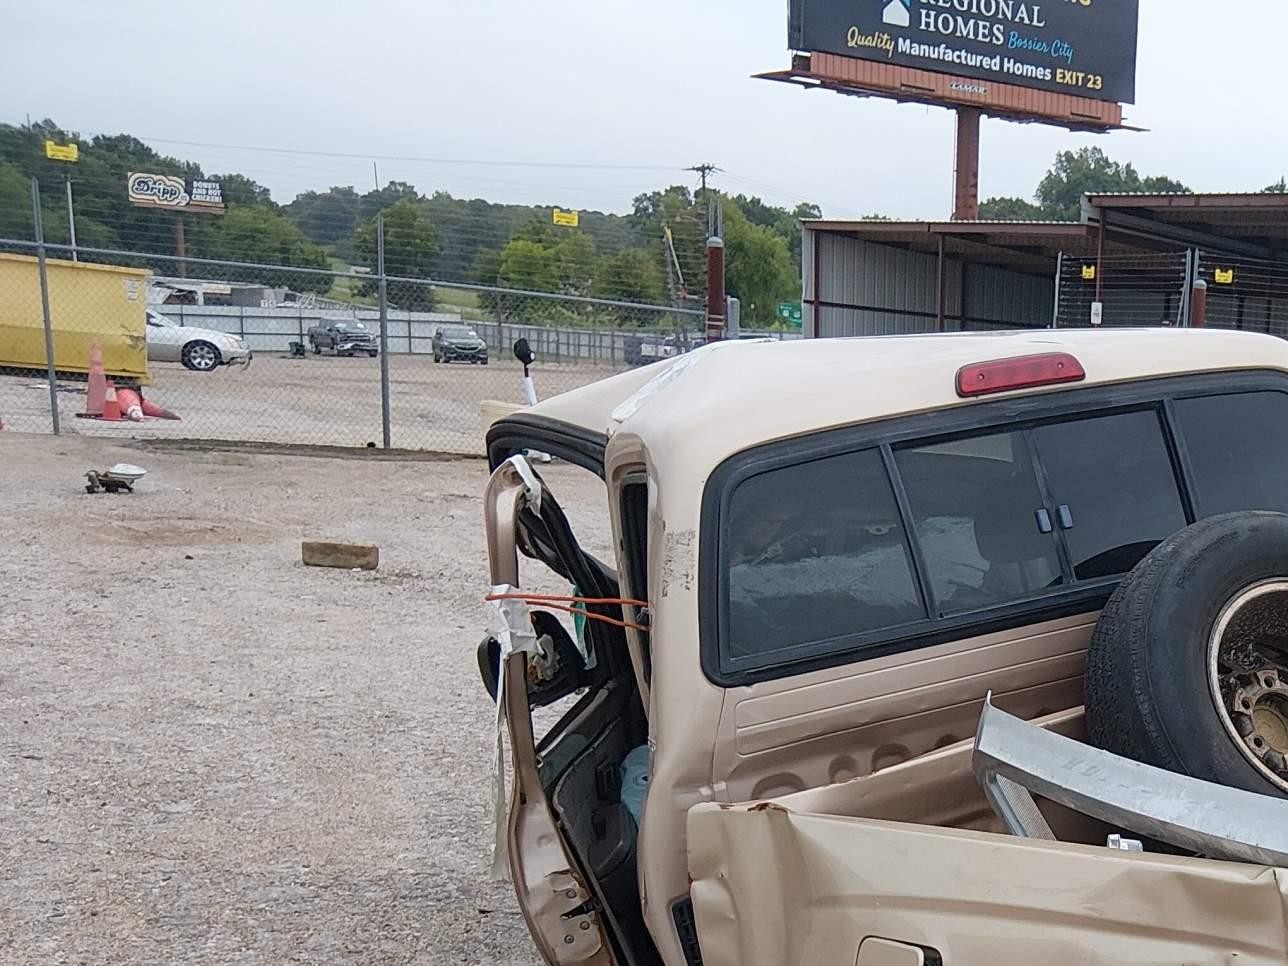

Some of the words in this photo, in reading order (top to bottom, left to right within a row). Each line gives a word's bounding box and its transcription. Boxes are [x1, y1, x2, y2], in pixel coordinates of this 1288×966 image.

[919, 9, 1004, 45] HOMES
[847, 26, 895, 59] Quality
[898, 37, 1000, 71] Manufactured
[1003, 57, 1052, 81] Homes
[1055, 68, 1085, 86] EXIT
[1086, 74, 1102, 90] 23
[1008, 31, 1050, 53] Bossier
[1050, 39, 1074, 64] City
[135, 179, 178, 199] Dripp
